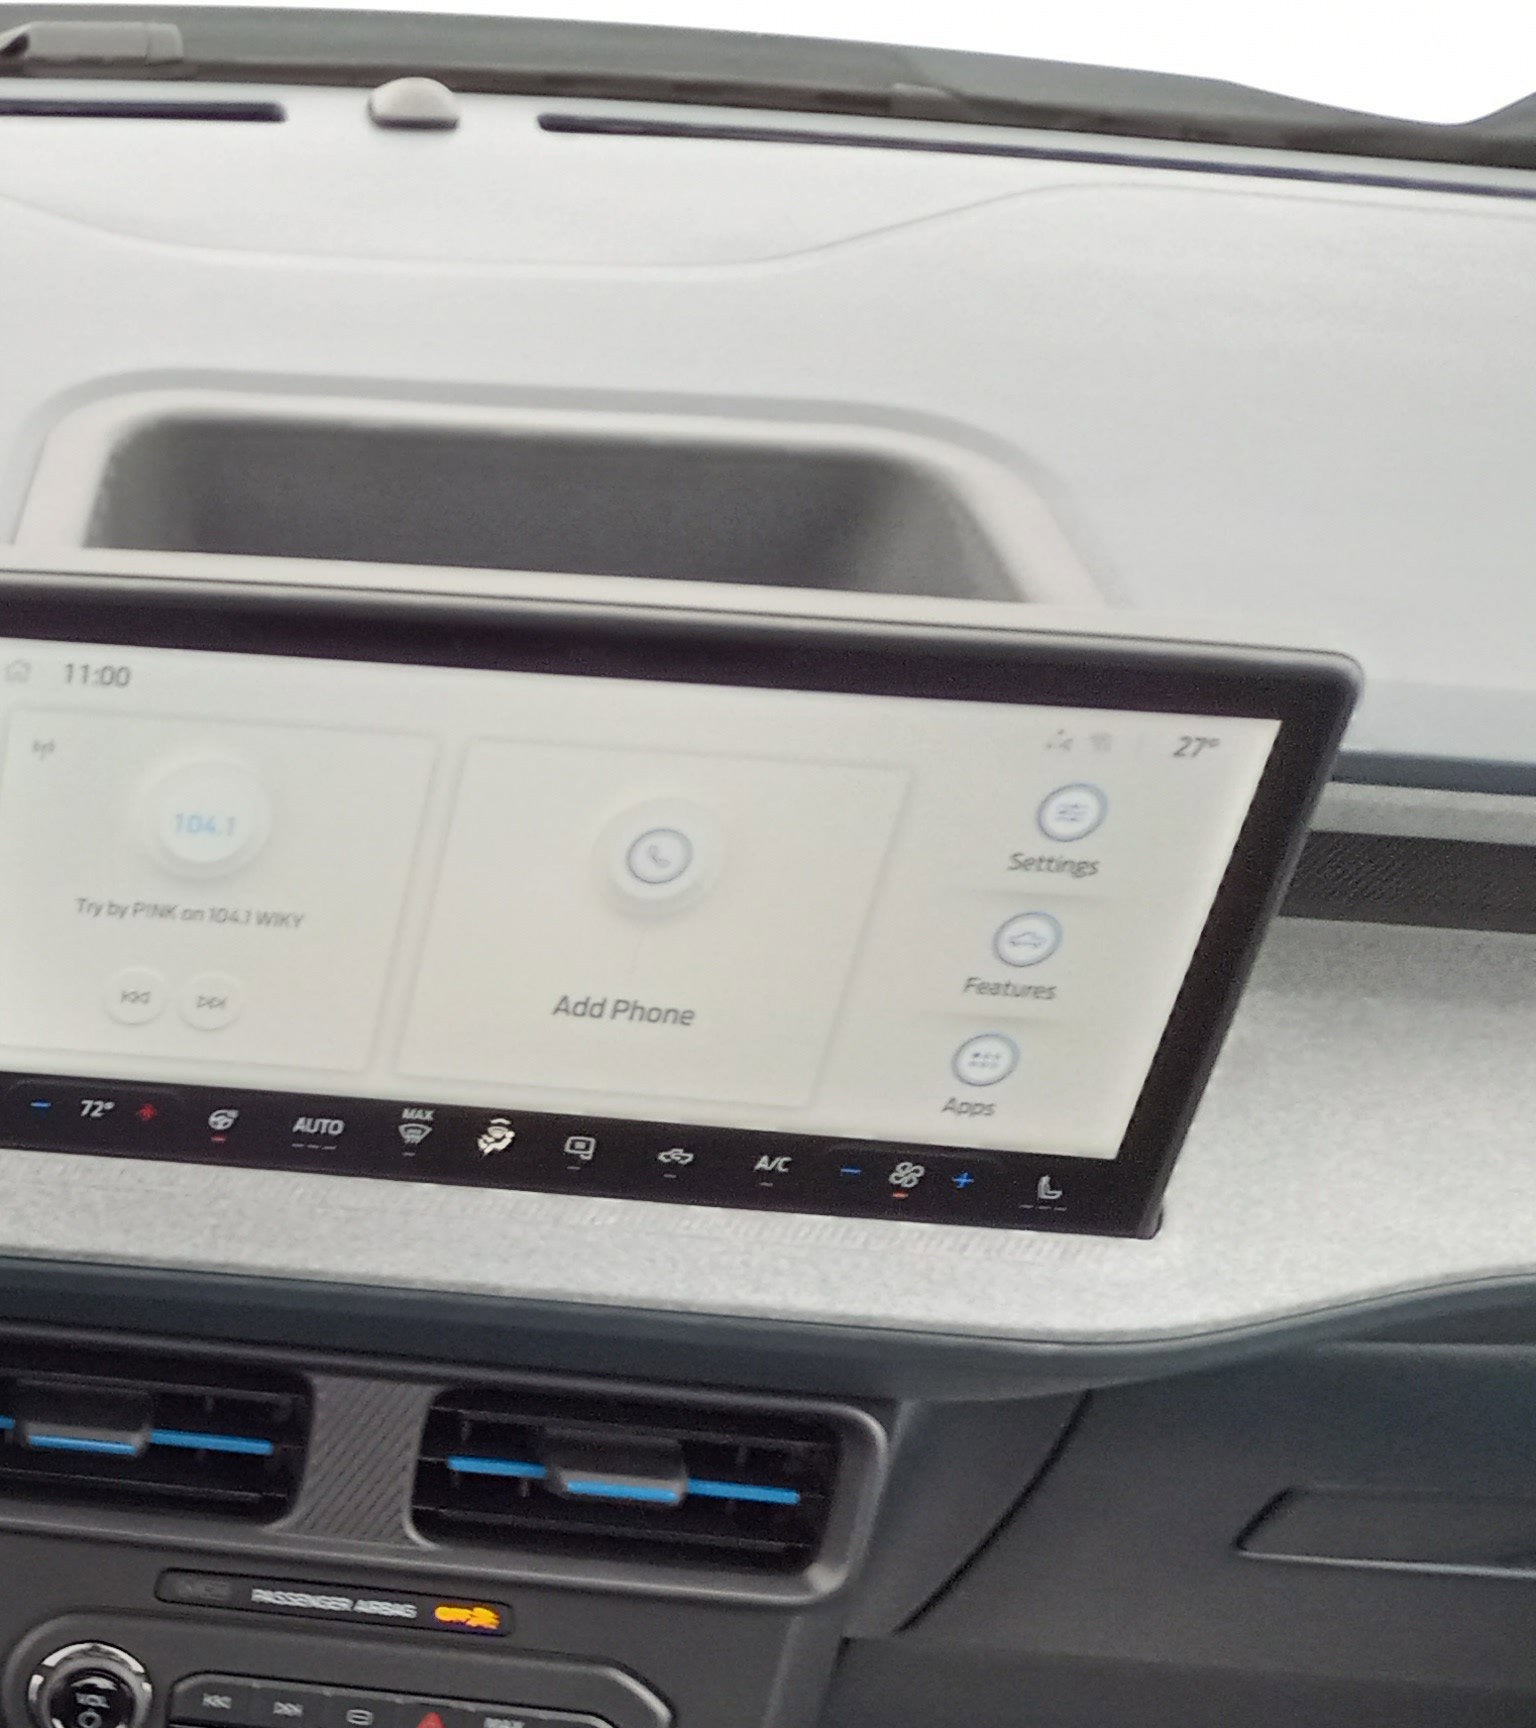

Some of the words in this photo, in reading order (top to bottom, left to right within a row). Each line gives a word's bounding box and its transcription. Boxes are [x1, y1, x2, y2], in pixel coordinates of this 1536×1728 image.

[64, 662, 131, 688] 11:00
[174, 812, 236, 837] 104.1
[1007, 850, 1100, 879] Settings
[75, 898, 103, 918] Try
[106, 899, 129, 919] by
[180, 908, 205, 922] on
[963, 975, 1057, 1001] Features
[552, 994, 609, 1021] Add
[611, 998, 696, 1028] Phone
[402, 1107, 434, 1122] MAX
[942, 1095, 996, 1118] Apps
[293, 1117, 345, 1138] AUTO
[754, 1154, 792, 1174] A/C
